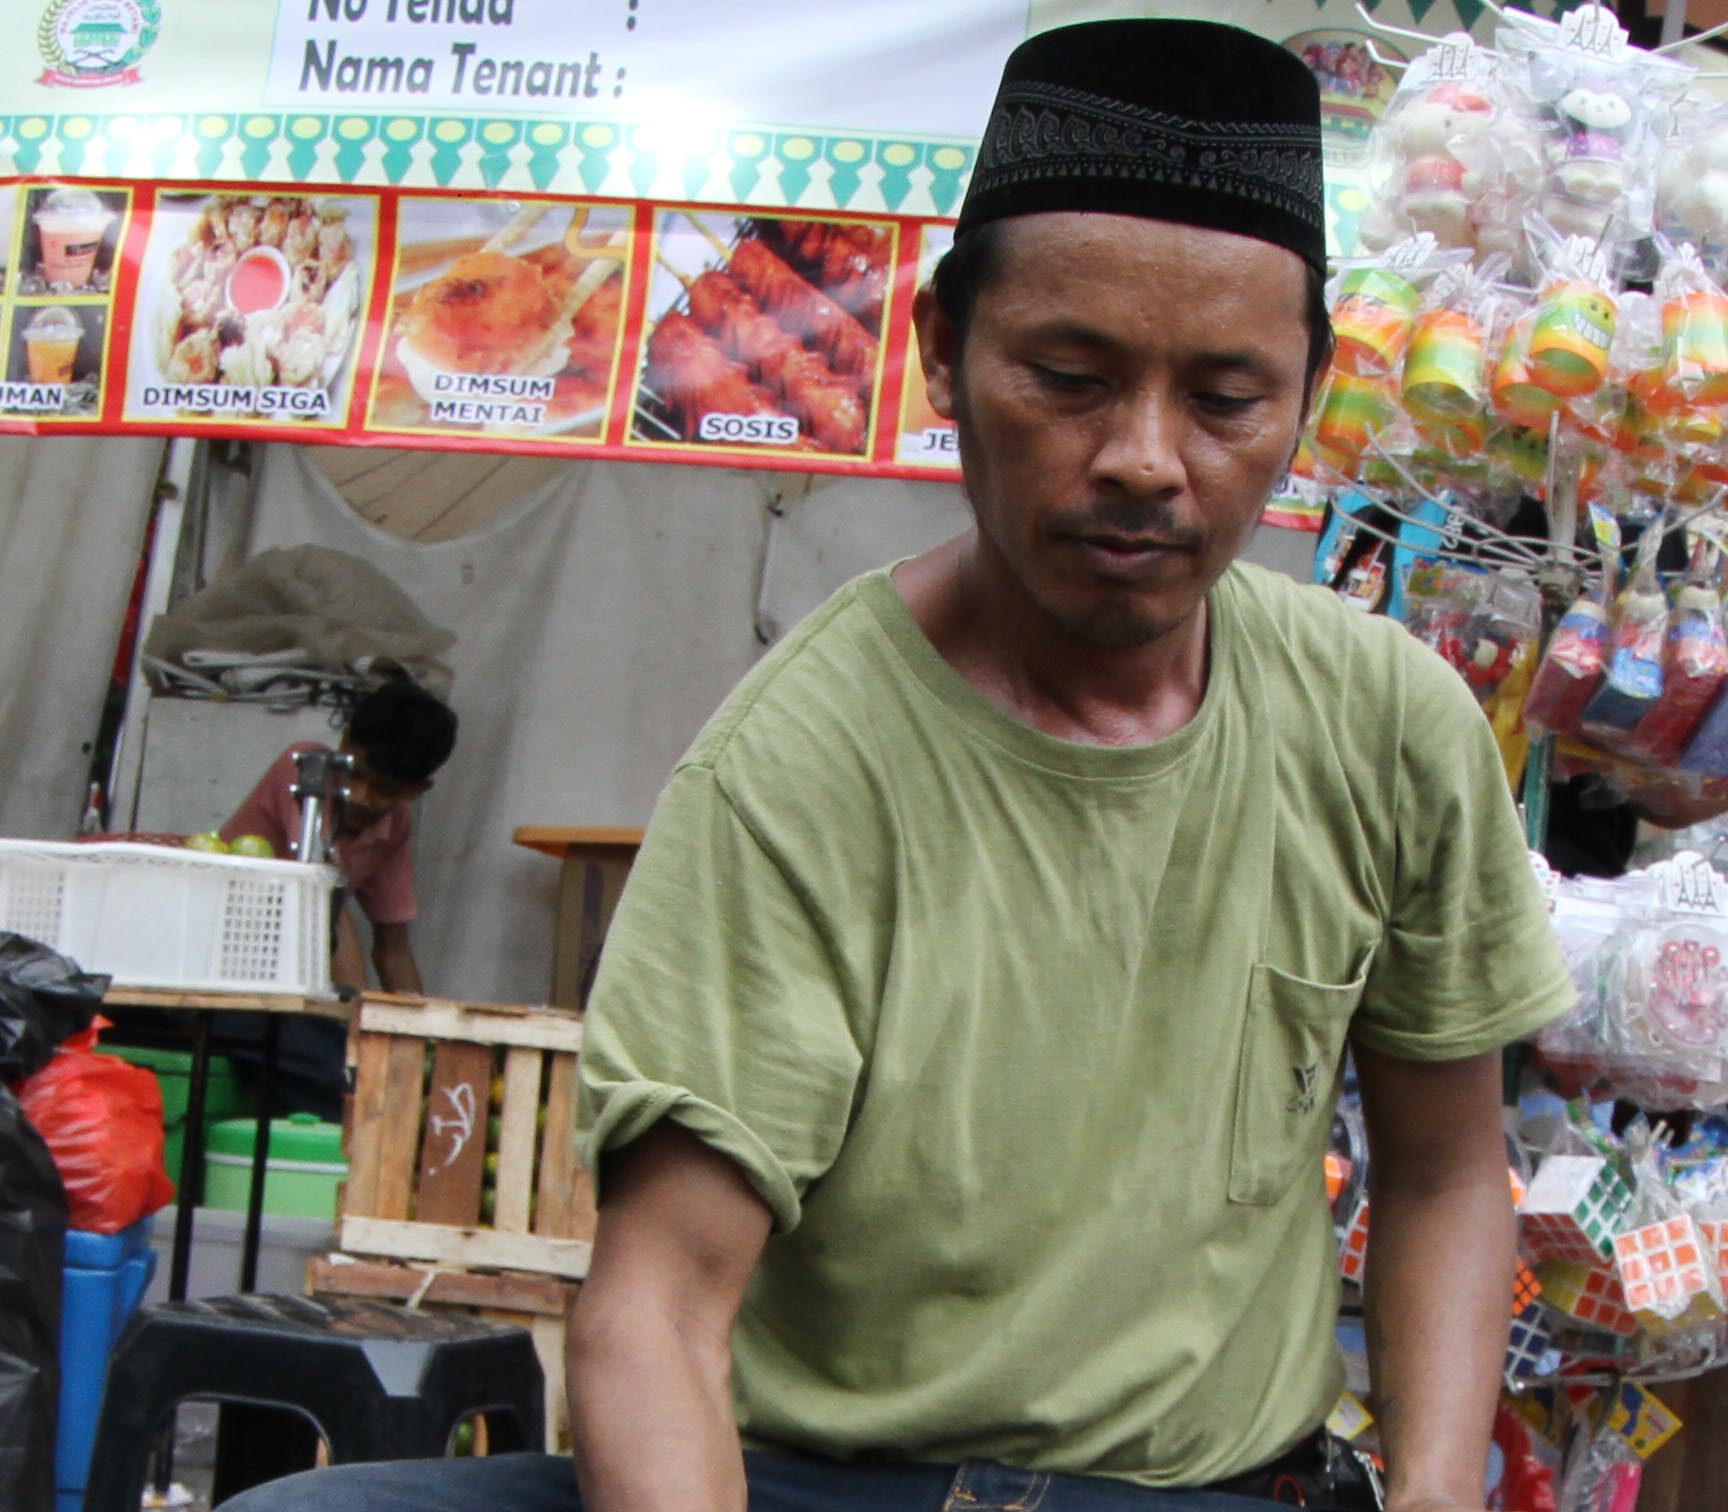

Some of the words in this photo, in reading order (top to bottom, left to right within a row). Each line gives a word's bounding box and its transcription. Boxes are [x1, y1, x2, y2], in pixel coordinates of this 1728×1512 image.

[298, 39, 435, 93] Nama
[451, 42, 602, 98] Tenant
[144, 386, 252, 409] DIMSUM
[259, 390, 328, 411] SIGA
[434, 376, 552, 398] DIMSUM
[433, 400, 544, 424] MENTAI
[704, 417, 795, 440] SOSIS
[923, 431, 960, 452] JE
